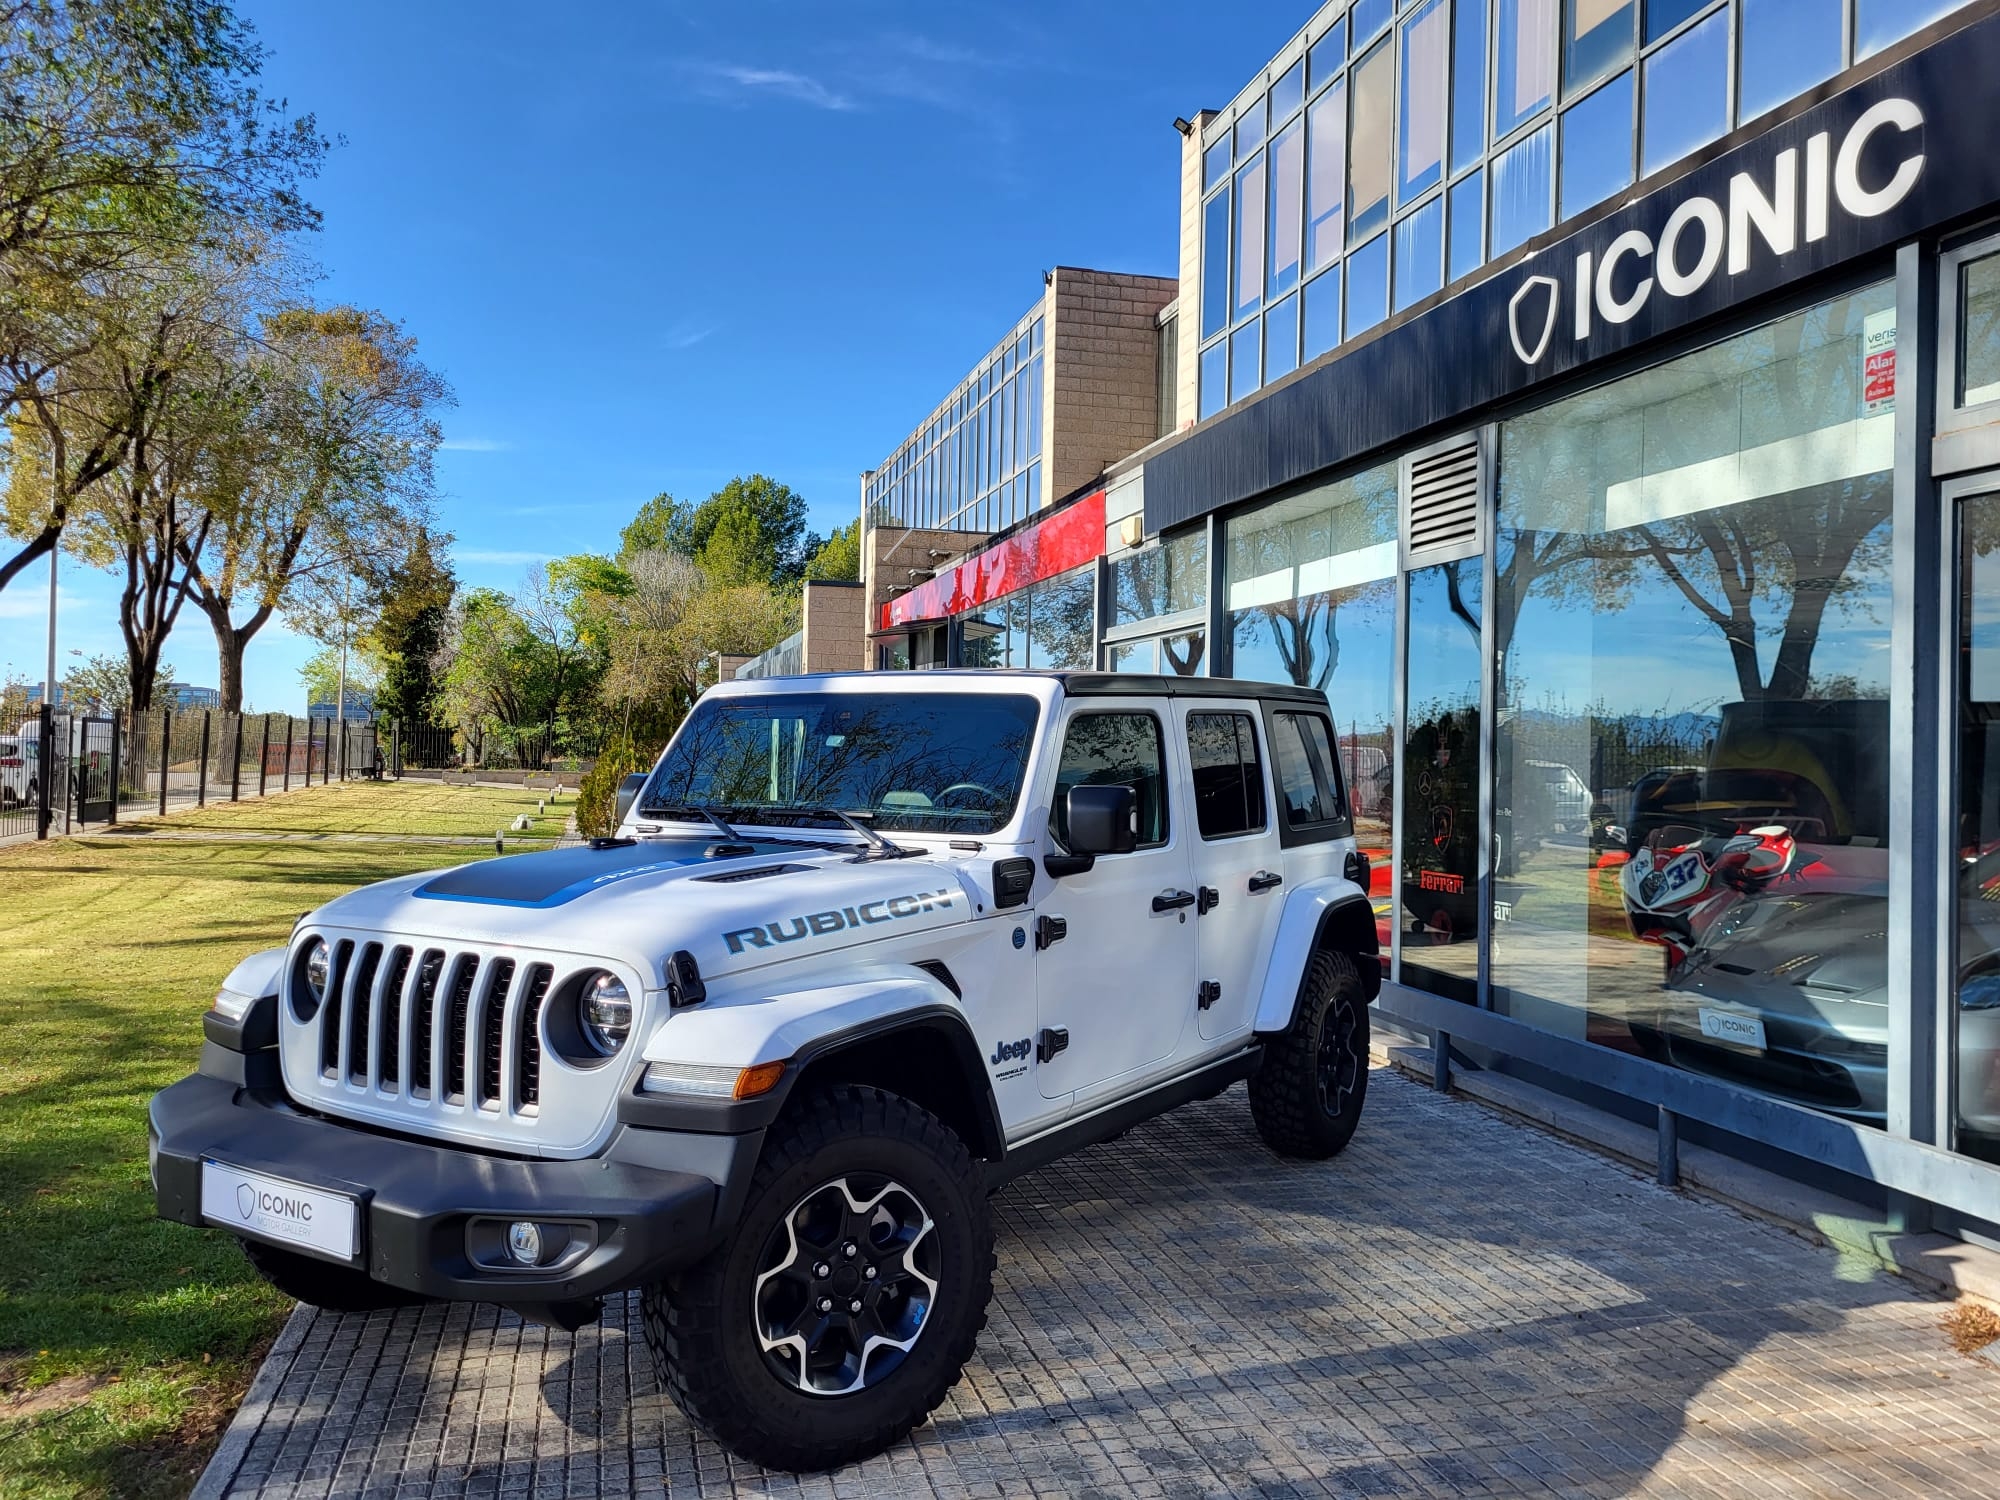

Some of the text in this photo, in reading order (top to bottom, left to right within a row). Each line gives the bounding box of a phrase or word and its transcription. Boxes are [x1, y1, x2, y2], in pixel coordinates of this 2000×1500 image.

[1575, 98, 1927, 340] ICONIC
[1420, 870, 1464, 896] Ferrari
[1666, 856, 1699, 891] 37
[722, 889, 953, 954] RUBICON
[1721, 1019, 1756, 1036] ICONIC
[991, 1038, 1031, 1065] Jeep
[258, 1190, 313, 1221] ICONIC
[257, 1215, 312, 1237] MOTOR GALLERY
